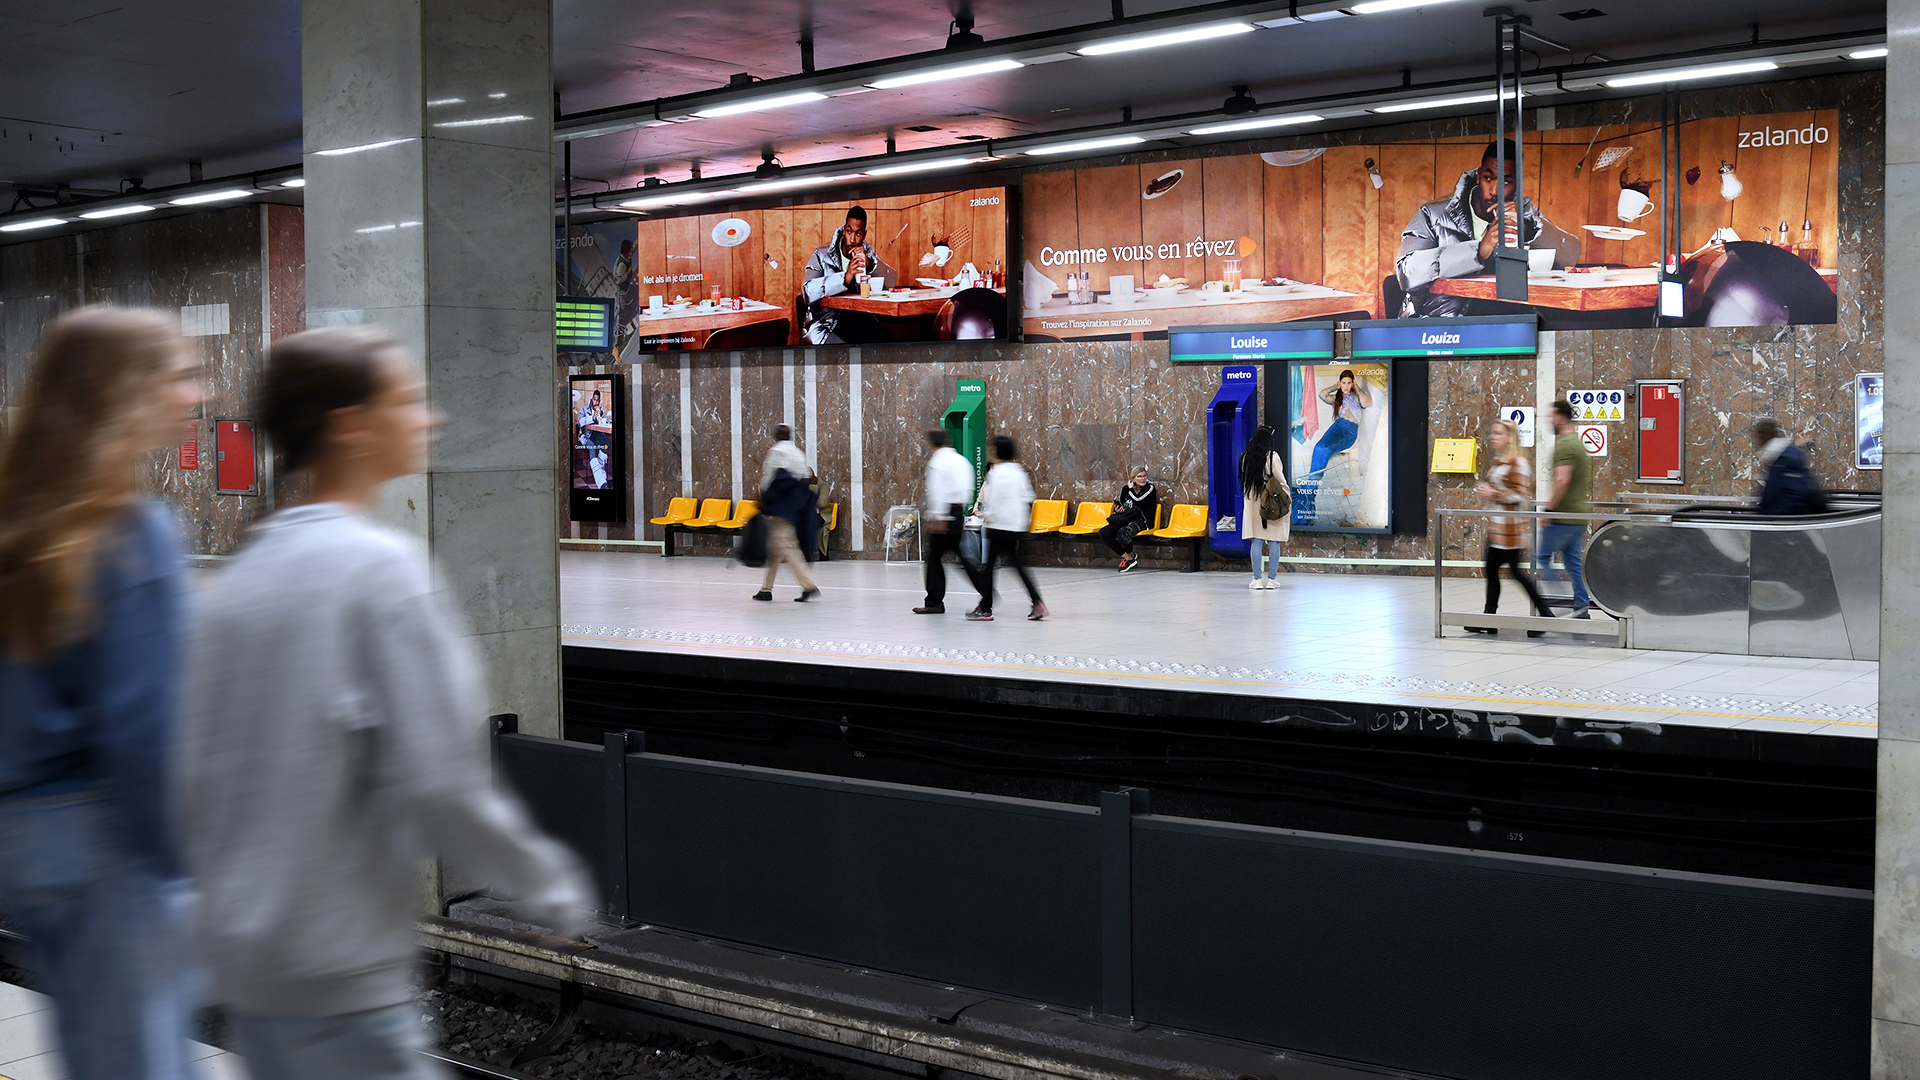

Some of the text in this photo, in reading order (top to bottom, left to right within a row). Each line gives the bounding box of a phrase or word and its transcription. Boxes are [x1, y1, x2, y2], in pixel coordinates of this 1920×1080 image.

[1738, 122, 1829, 148] zalando
[969, 195, 1000, 207] zalando
[555, 232, 594, 249] zaando
[1040, 235, 1235, 266] Comme vous en rêvez
[643, 272, 704, 284] Net als in je dromen
[733, 299, 740, 310] 30
[1041, 317, 1152, 329] Trouvez l'inspiration sur Zalando
[1231, 335, 1268, 349] Louise
[1421, 331, 1460, 345] Louiza
[1227, 371, 1252, 379] metro
[1356, 367, 1384, 376] zalando
[960, 384, 981, 392] metro
[1296, 478, 1323, 486] Comme
